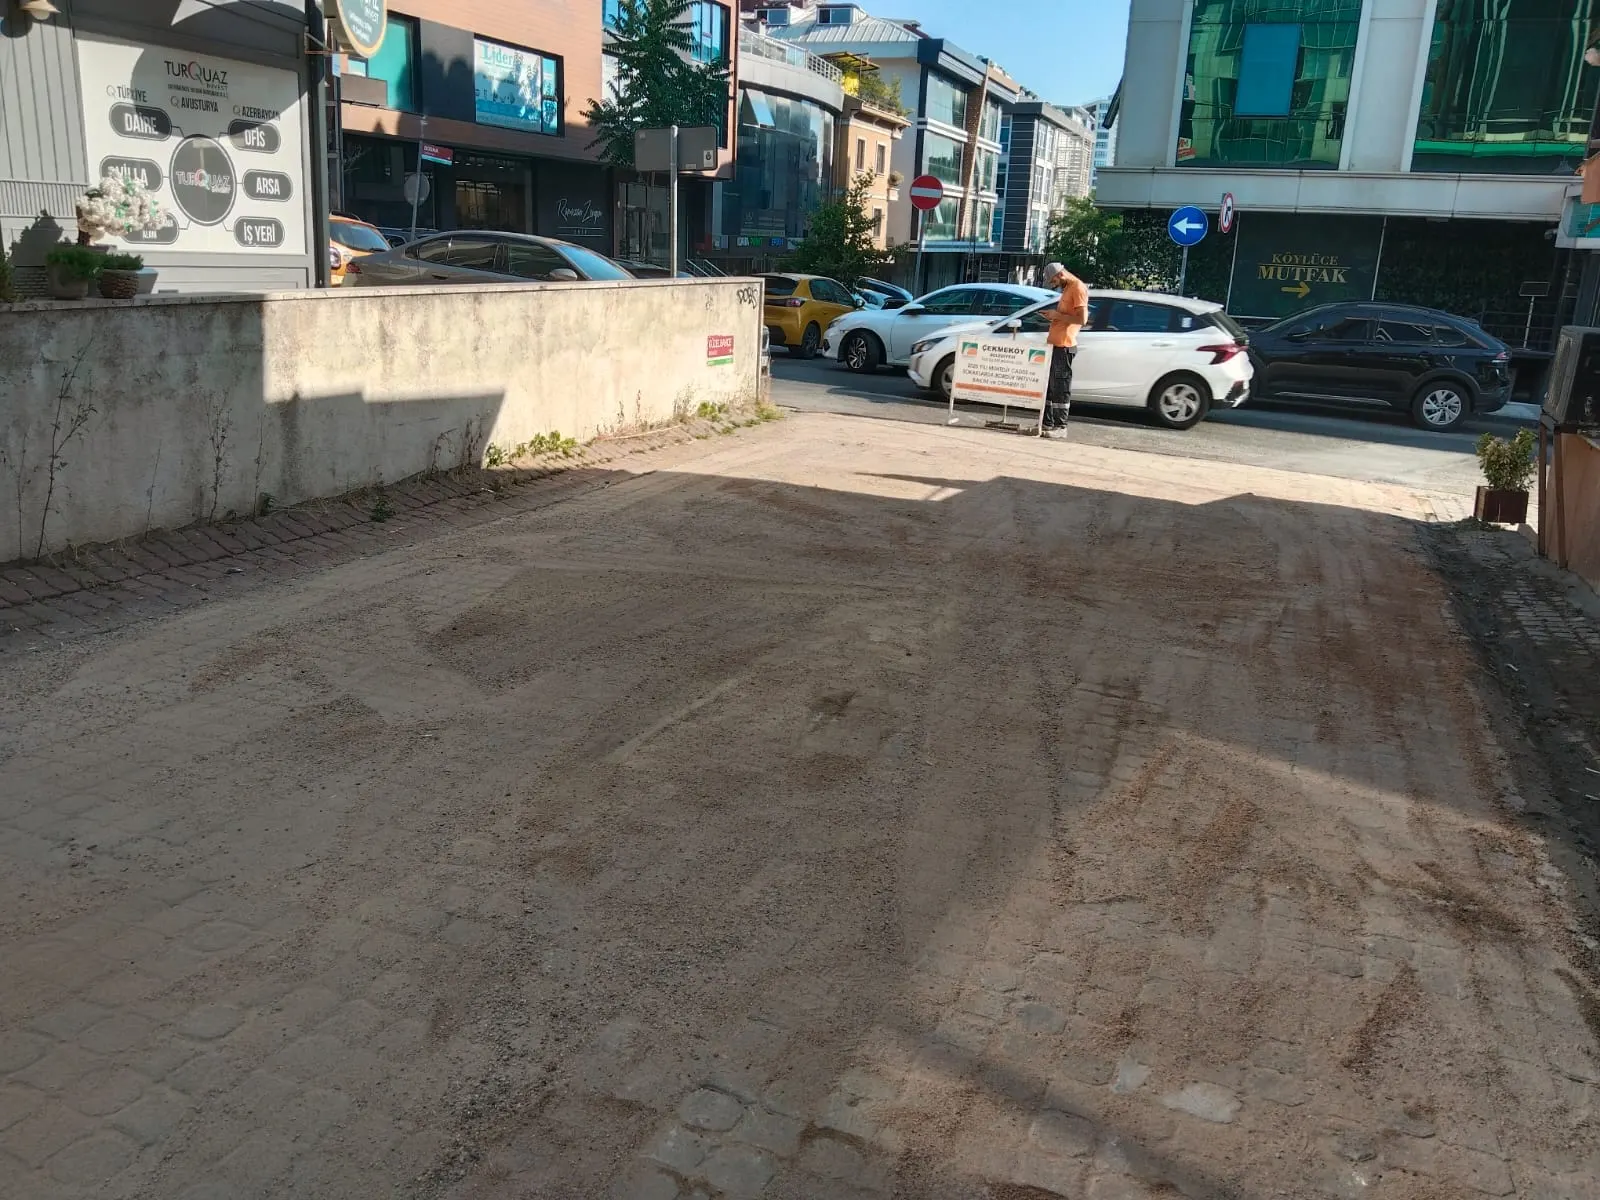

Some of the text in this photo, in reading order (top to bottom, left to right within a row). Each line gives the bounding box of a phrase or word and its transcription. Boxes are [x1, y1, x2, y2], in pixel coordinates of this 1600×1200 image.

[164, 60, 229, 85] TURQUAZ
[117, 85, 148, 103] TÜRKİYE
[181, 97, 219, 112] AVUSTURYA
[242, 105, 281, 121] AZERBAYCAN
[124, 112, 159, 134] DAİRE
[244, 127, 266, 147] OFİS
[256, 177, 281, 196] ARSA
[243, 222, 276, 245] İŞ YERİ
[1272, 252, 1339, 266] KÖYLÜCE
[1258, 265, 1348, 283] MUTFAK
